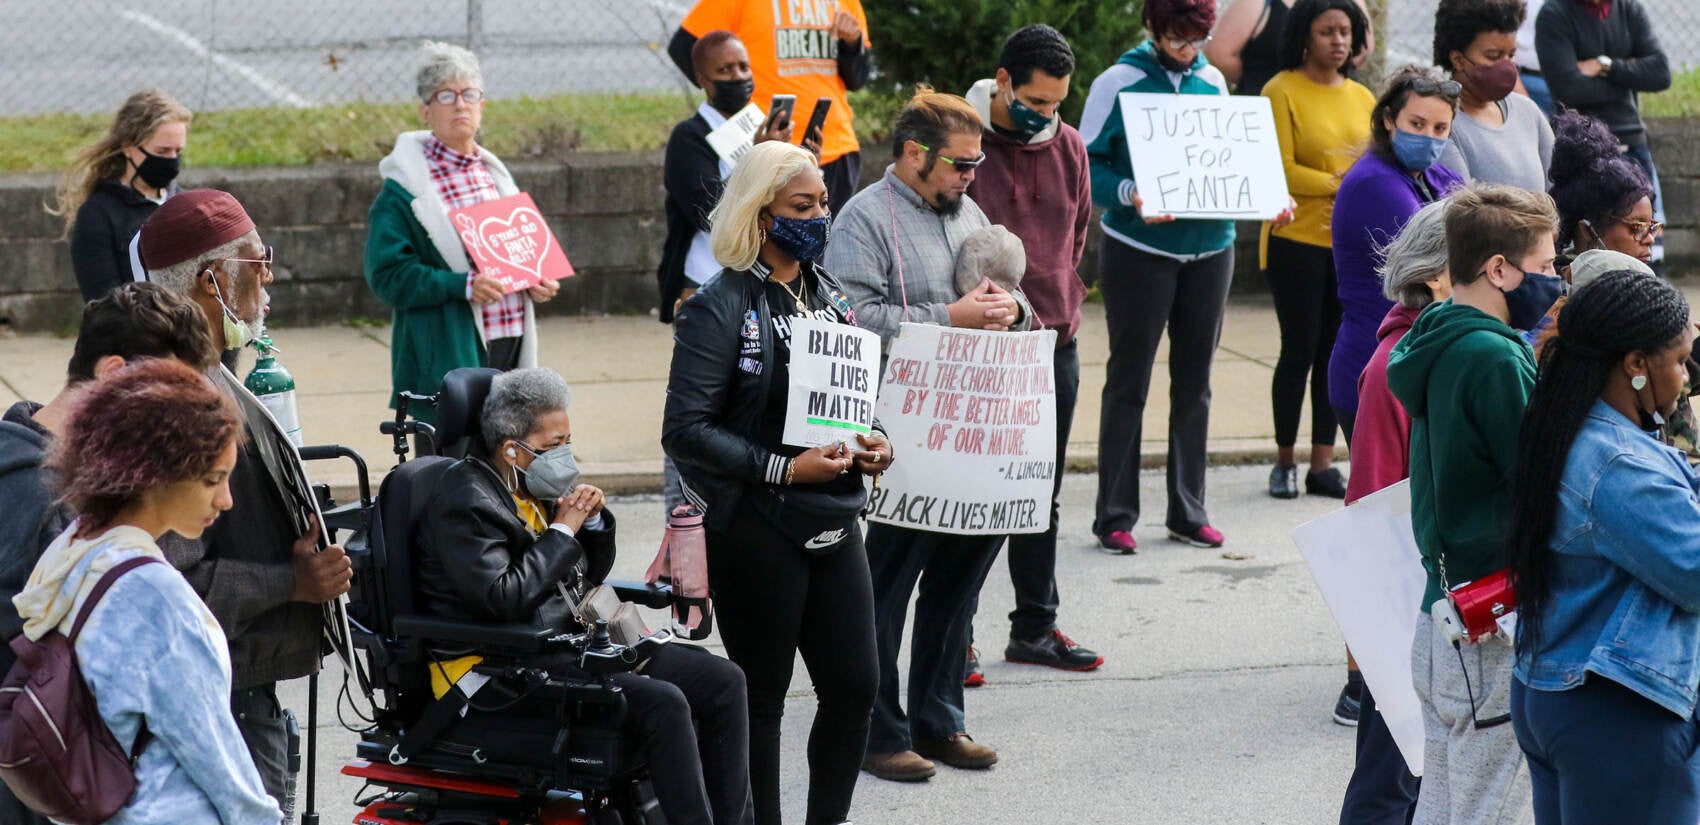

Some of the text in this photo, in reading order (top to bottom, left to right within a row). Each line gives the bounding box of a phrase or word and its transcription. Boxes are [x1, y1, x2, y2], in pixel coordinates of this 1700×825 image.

[1141, 107, 1261, 142] JUSTICE
[1185, 144, 1232, 168] FOR
[1157, 171, 1253, 209] FANTA
[808, 329, 862, 361] BLACK
[935, 331, 981, 362] EVERY
[830, 362, 868, 393] LIVES
[887, 358, 930, 387] SWELL
[934, 363, 961, 390] THE
[960, 367, 1007, 394] CHORUS
[1006, 366, 1016, 396] OF
[1014, 366, 1030, 396] OUR
[807, 391, 872, 425] MATTER
[902, 389, 1041, 426] BY THE BETTER ANGELS
[927, 423, 1029, 456] OF OUR NATURE.
[1016, 461, 1054, 480] LINCOLN
[865, 487, 1038, 530] BLACK LIVES MATTER.
[814, 528, 844, 542] NIKE
